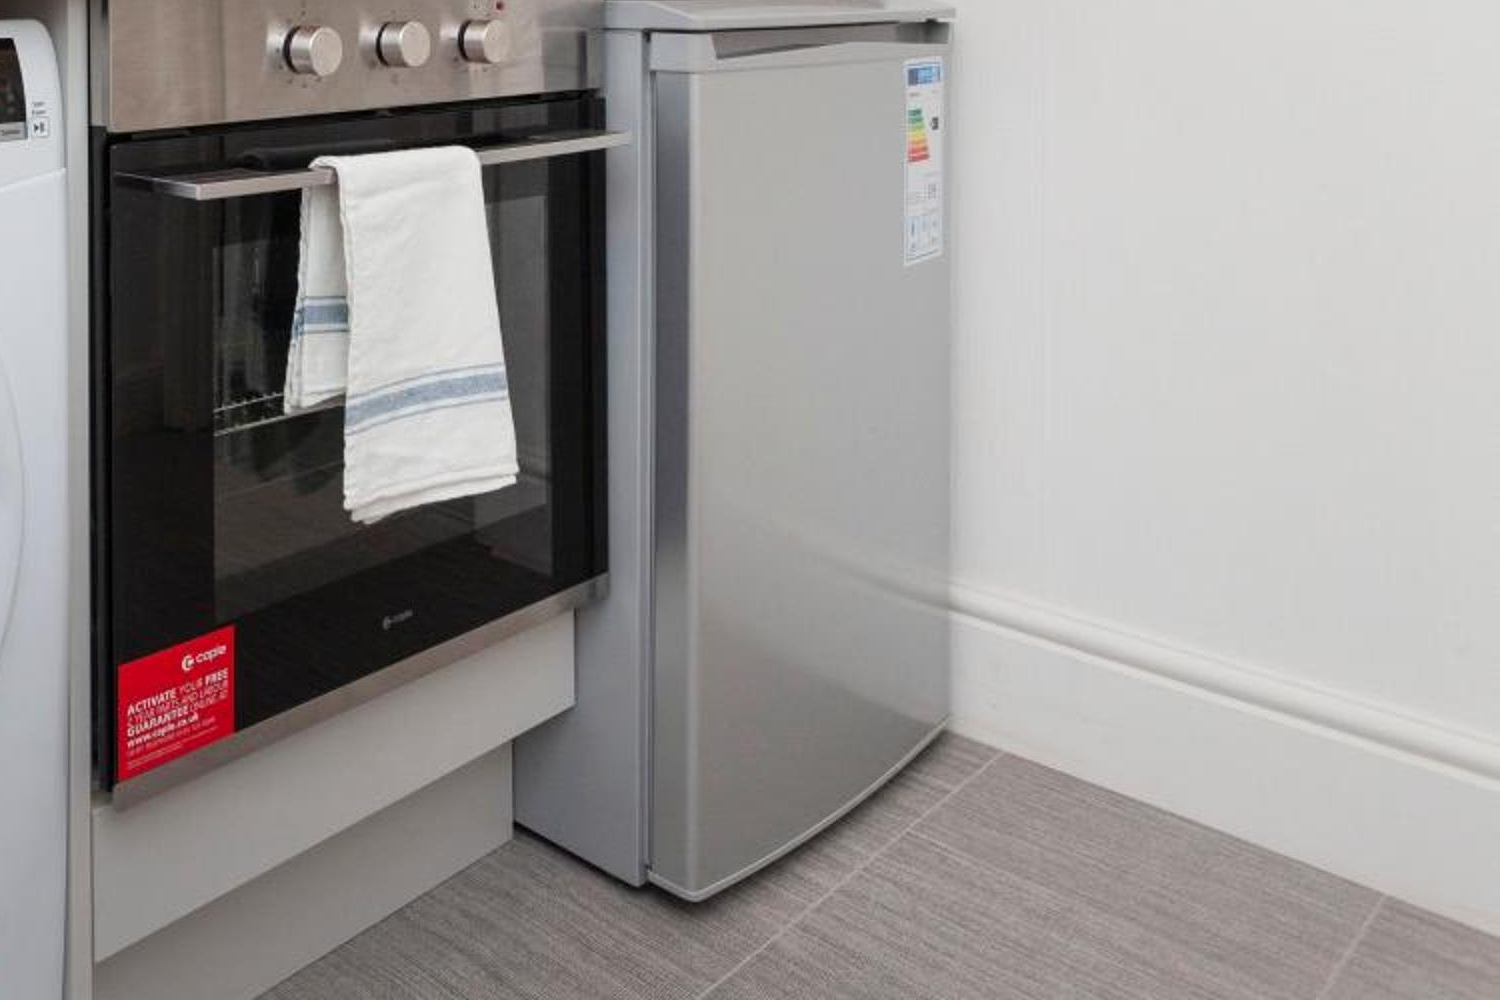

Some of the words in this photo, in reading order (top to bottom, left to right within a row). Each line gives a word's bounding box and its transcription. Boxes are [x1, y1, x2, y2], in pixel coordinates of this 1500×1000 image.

[195, 645, 227, 663] caple
[127, 687, 177, 716] ACTIVATE
[179, 677, 203, 694] YOUR
[204, 668, 228, 685] FREE
[127, 705, 188, 737] GUARANTEE
